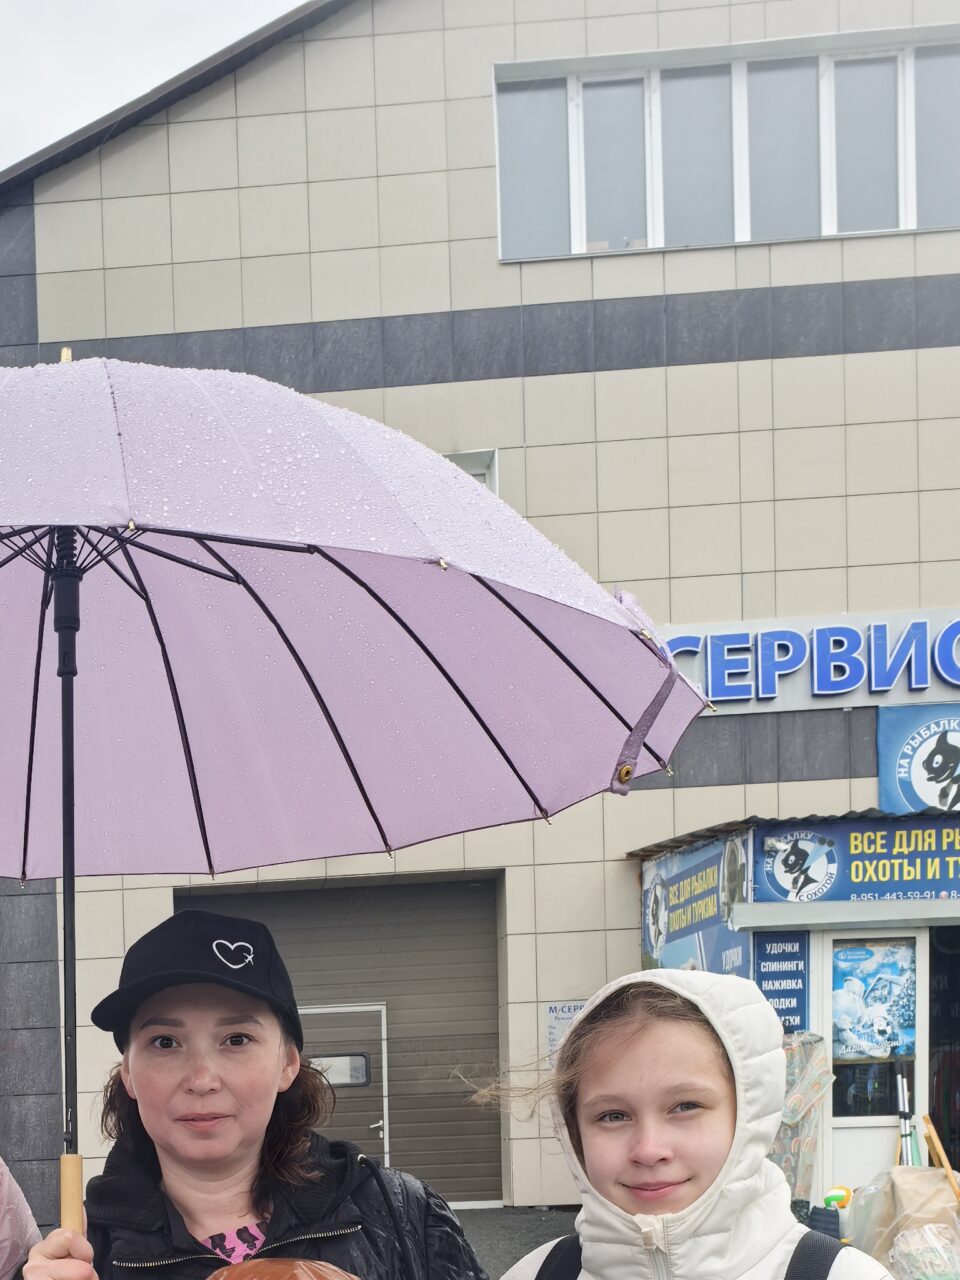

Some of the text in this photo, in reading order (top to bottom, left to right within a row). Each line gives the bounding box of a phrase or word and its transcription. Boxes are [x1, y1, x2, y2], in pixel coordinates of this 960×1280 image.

[897, 758, 910, 777] НА
[850, 831, 888, 855] ВСЕ
[892, 829, 937, 855] ДЛЯ
[851, 858, 921, 883] ОХОТЫ
[927, 857, 940, 880] И
[806, 872, 836, 900] ОХОТОЙ
[850, 891, 935, 901] 8-951-443-59-91
[765, 942, 800, 954] УДОЧКИ
[761, 960, 804, 973] СПИНИНГИ
[762, 979, 803, 991] НАЖИВКА
